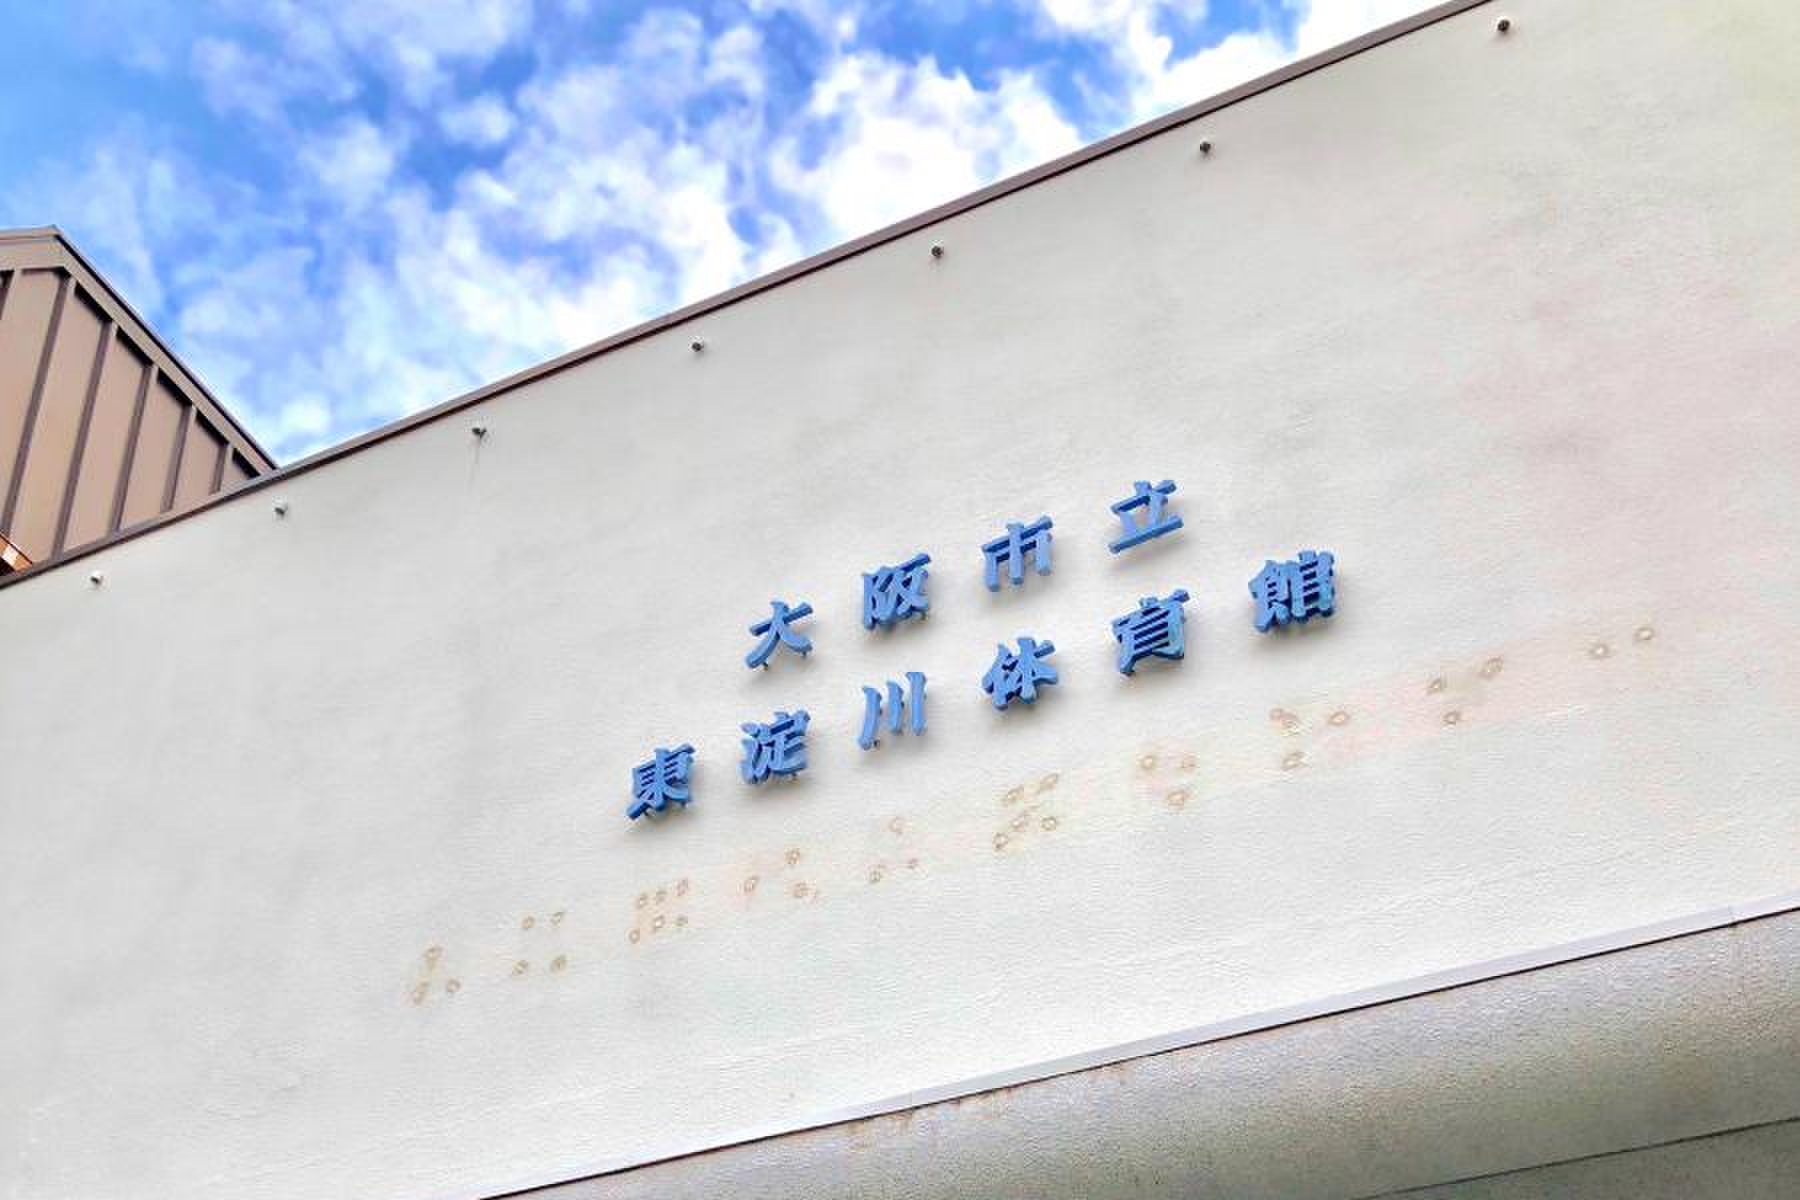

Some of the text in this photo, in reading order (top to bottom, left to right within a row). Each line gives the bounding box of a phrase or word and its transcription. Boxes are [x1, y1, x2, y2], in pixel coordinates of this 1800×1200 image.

[626, 550, 1336, 820] 東淀川体育館
[746, 479, 1184, 670] 大阪市立
